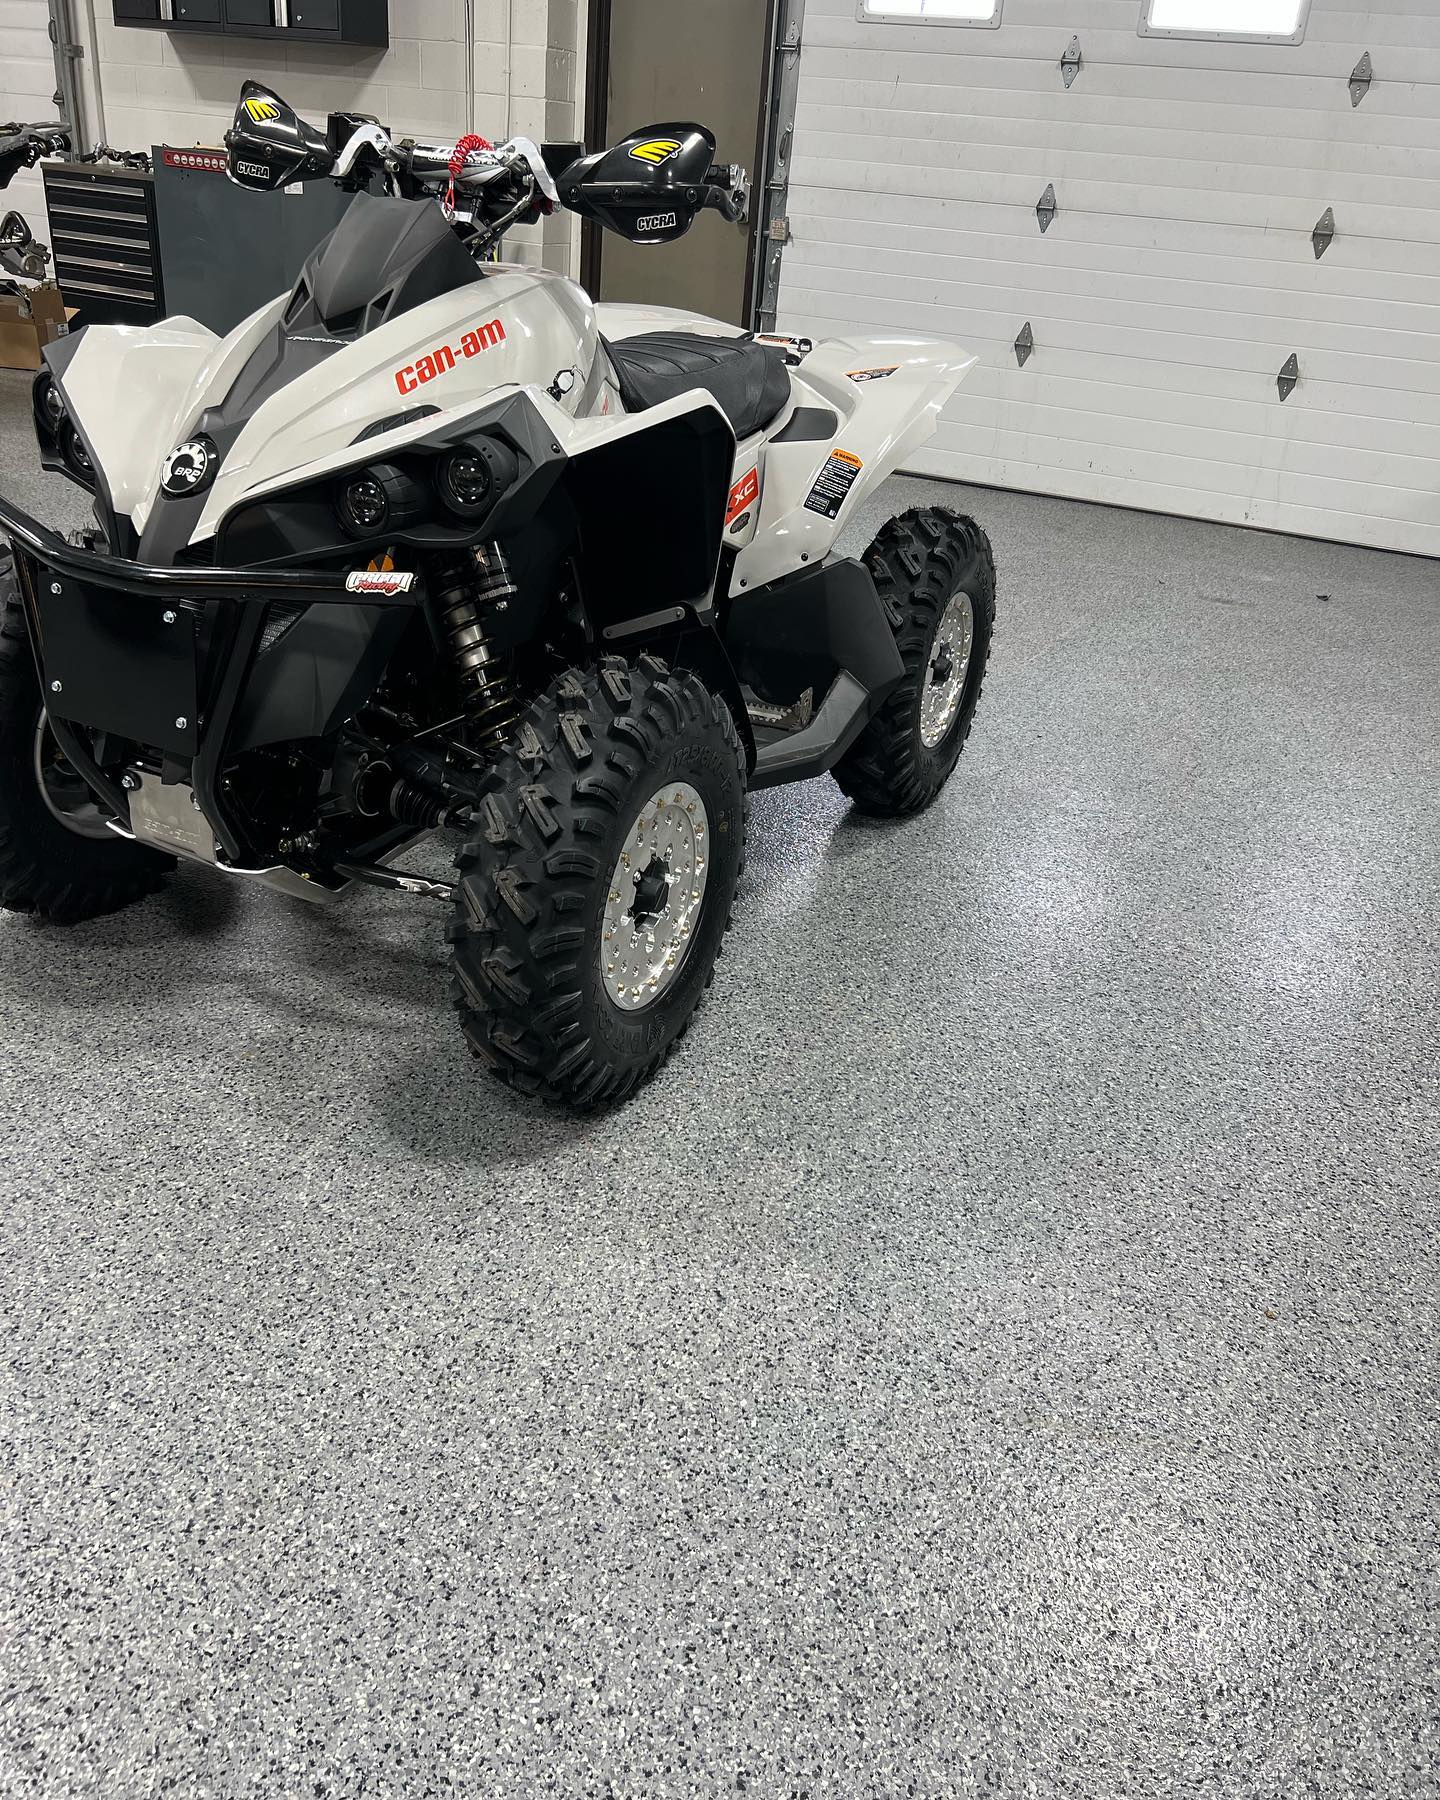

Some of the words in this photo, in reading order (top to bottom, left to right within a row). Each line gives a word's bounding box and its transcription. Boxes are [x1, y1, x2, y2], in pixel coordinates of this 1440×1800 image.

[237, 161, 270, 179] CYCRA
[636, 213, 676, 231] CYCRA
[395, 319, 506, 396] can-am
[174, 466, 202, 477] BRP
